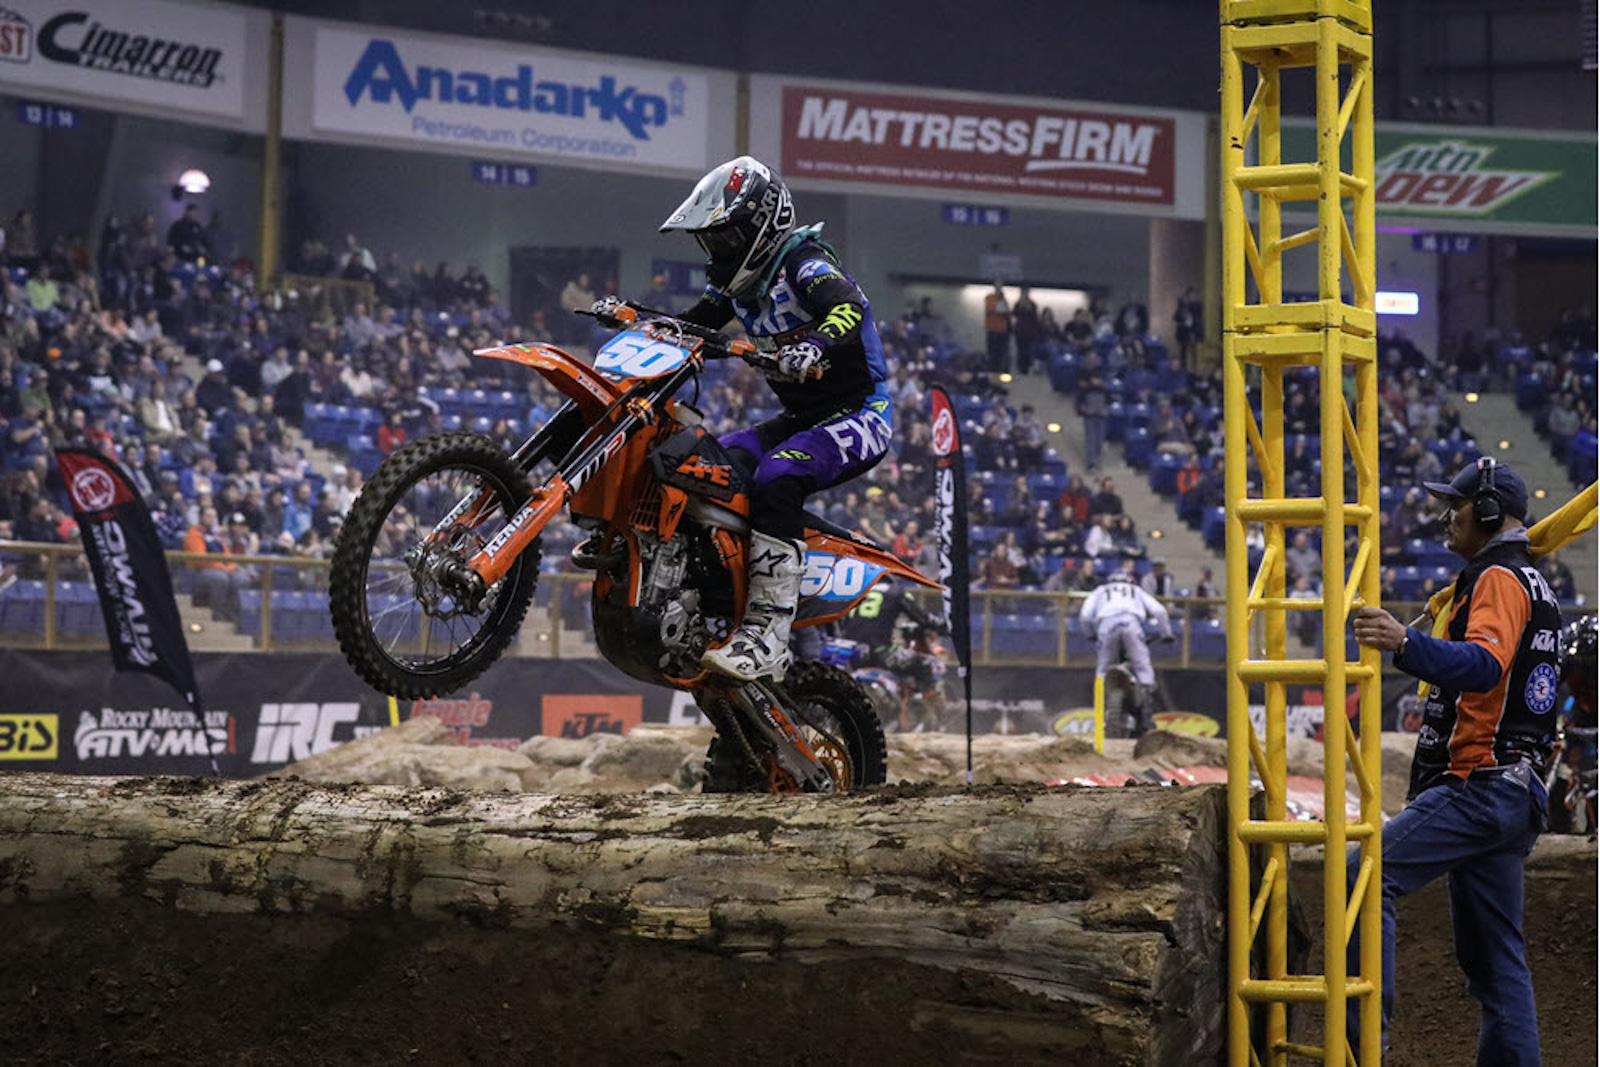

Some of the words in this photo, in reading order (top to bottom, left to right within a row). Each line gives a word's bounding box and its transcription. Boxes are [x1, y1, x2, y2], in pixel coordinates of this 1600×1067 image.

[37, 12, 224, 75] Cimarron
[343, 39, 668, 140] Anadarko
[411, 116, 515, 145] Petroleum
[521, 128, 637, 158] Corporation
[751, 182, 780, 228] FXR
[817, 303, 862, 338] FXR
[595, 334, 685, 378] 50
[484, 506, 534, 558] KENDA
[800, 555, 865, 597] 50
[101, 708, 150, 728] ROCKY
[152, 708, 229, 728] MOUNAIN
[561, 713, 624, 740] KTM
